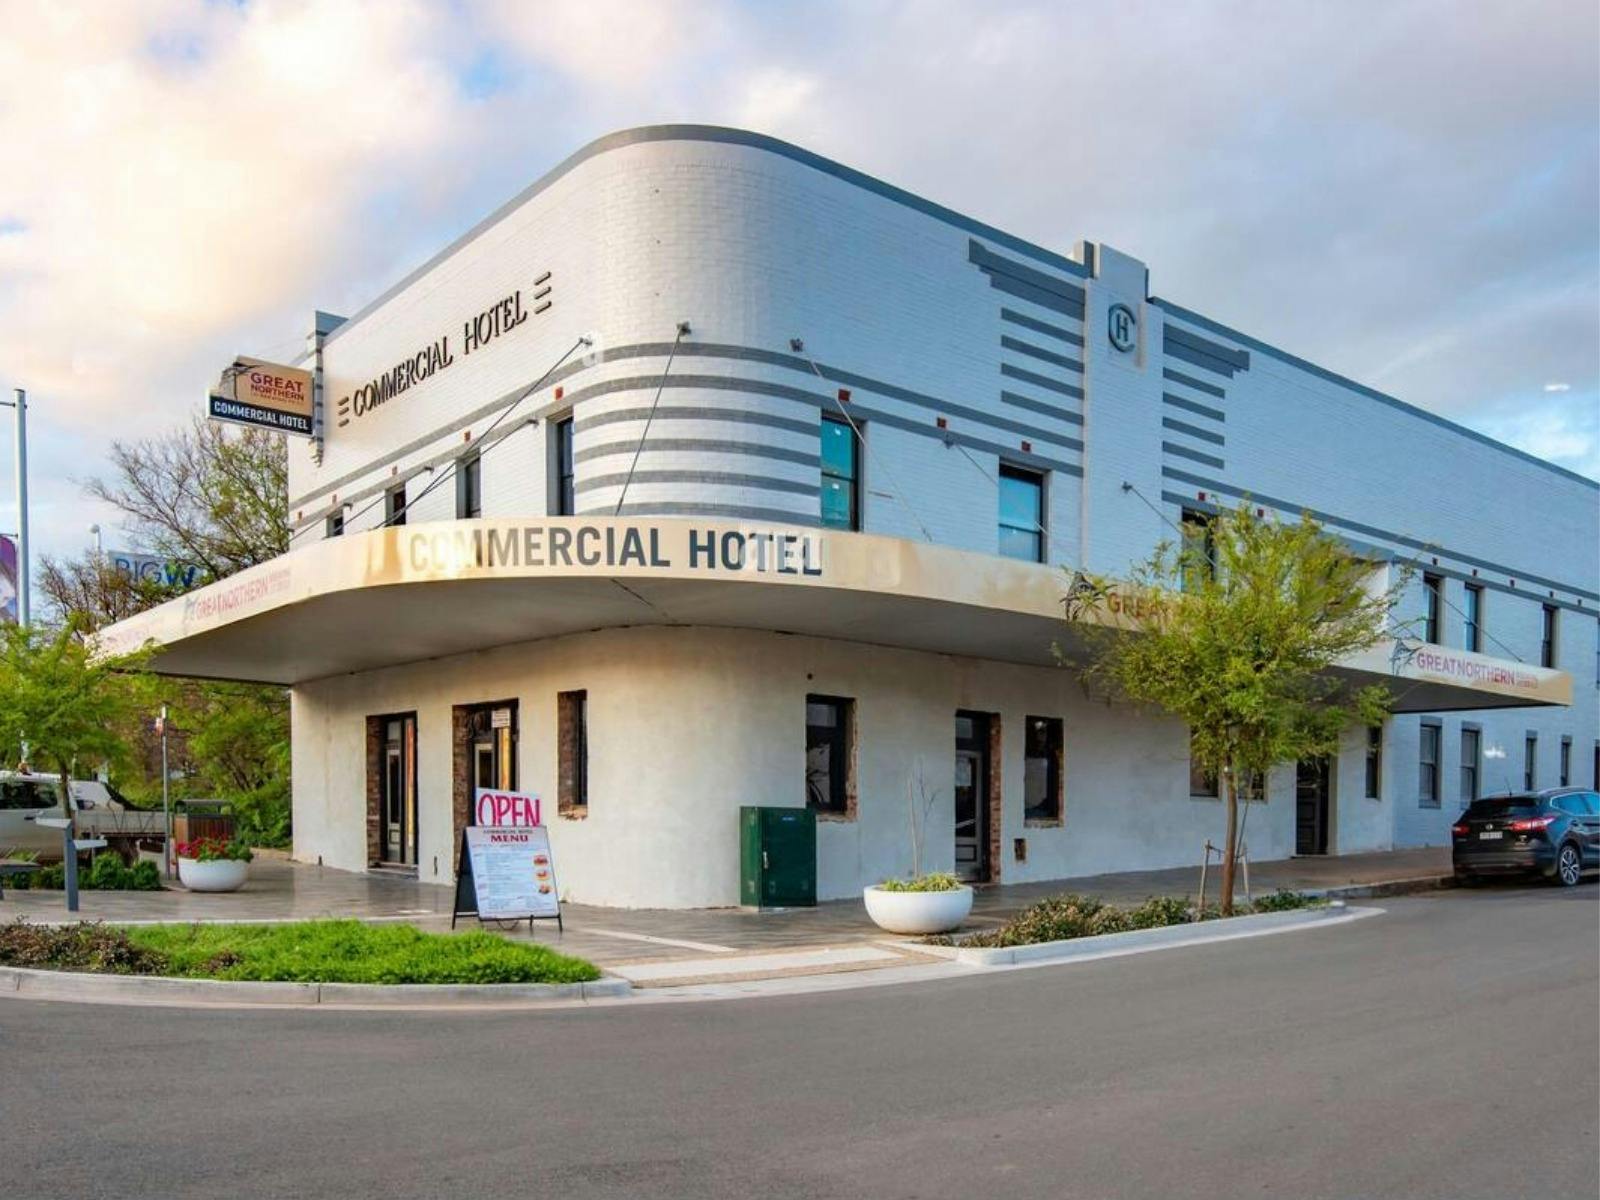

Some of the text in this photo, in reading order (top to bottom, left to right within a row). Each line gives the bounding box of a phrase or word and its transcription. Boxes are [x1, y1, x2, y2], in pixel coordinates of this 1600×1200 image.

[353, 290, 528, 417] COMMERCIAL HOTEL
[250, 372, 304, 393] GREAT
[250, 384, 304, 402] NORTHERN
[214, 401, 308, 430] COMMERCIAL HOTEL
[410, 525, 823, 577] COMMERCIAL HOTEL
[478, 793, 541, 827] OPEN
[490, 834, 529, 843] MENU
